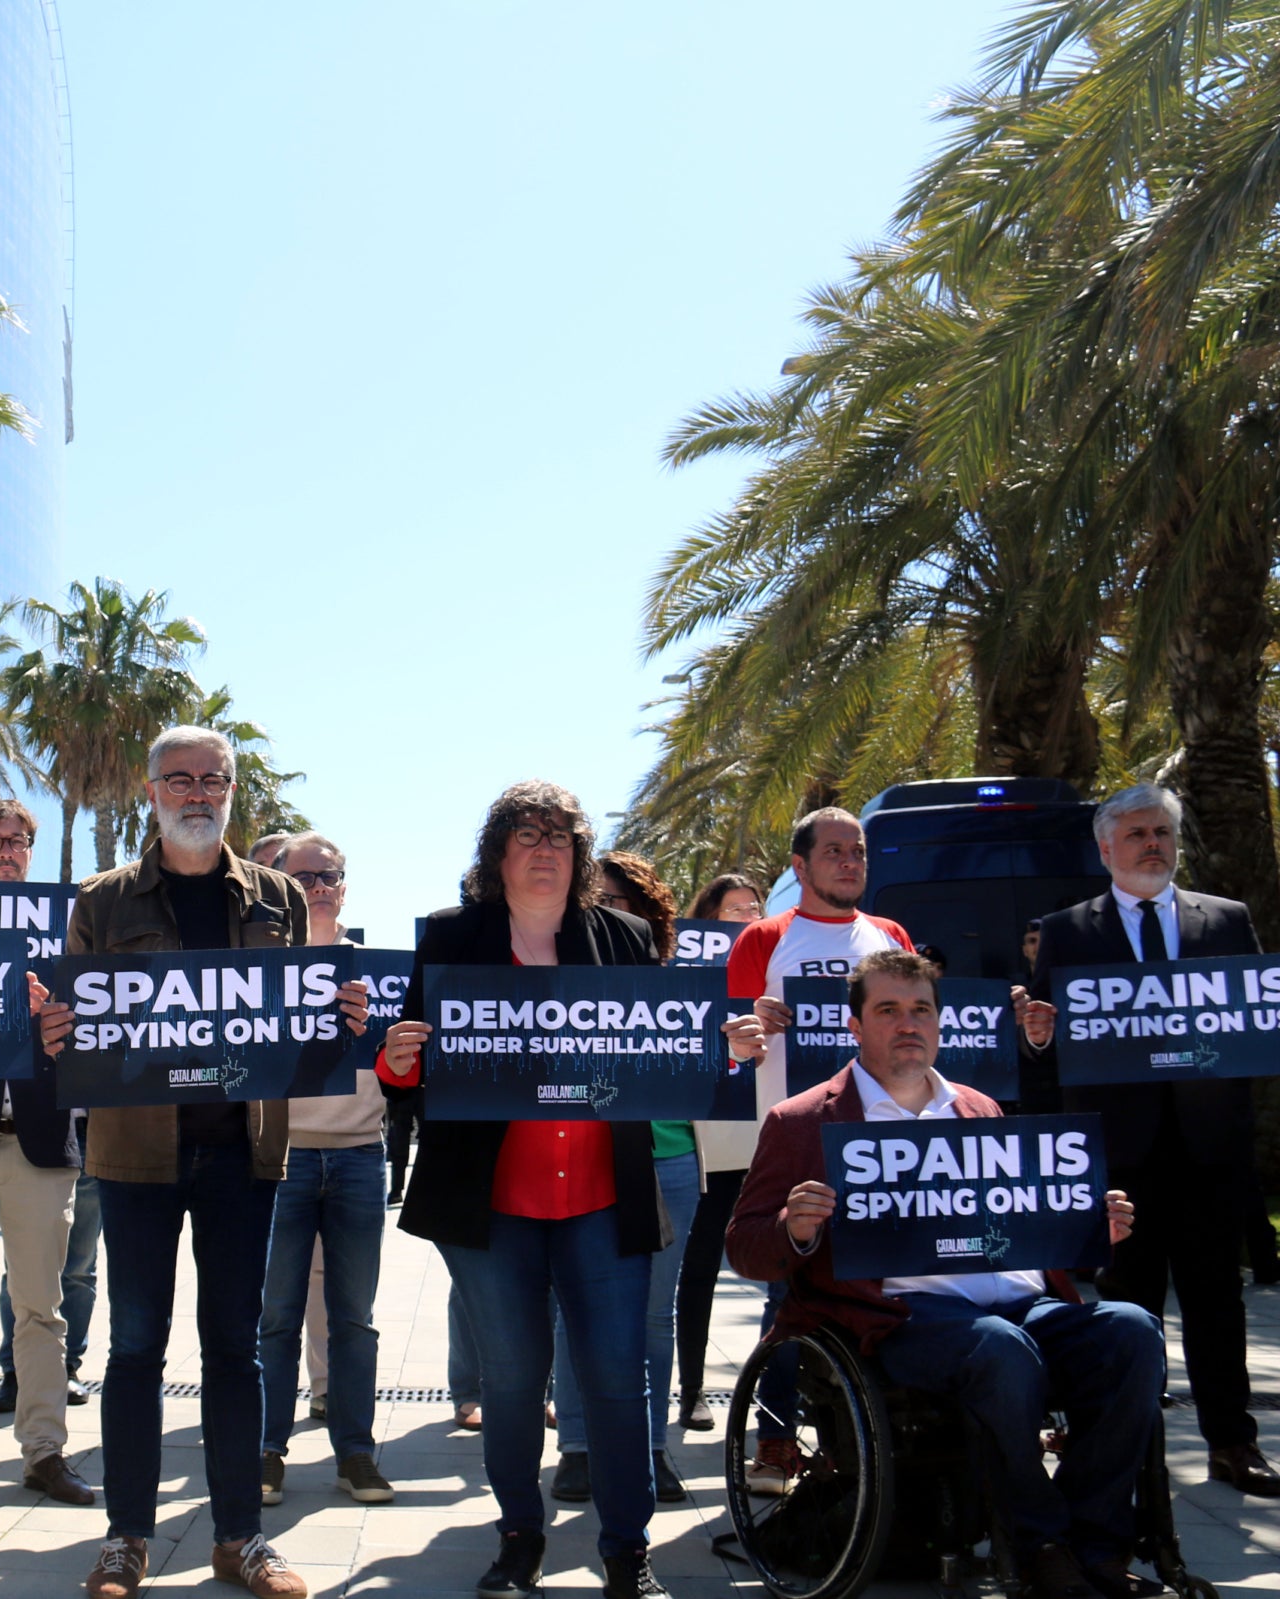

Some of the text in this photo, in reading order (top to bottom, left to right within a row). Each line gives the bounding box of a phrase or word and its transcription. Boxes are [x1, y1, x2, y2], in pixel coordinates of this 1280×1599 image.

[800, 959, 858, 977] RO
[73, 963, 337, 1016] SPAIN IS
[1066, 967, 1280, 1014] SPAIN IS
[440, 1000, 712, 1031] DEMOCRACY
[1069, 1009, 1280, 1041] SPYING ON U
[73, 1014, 338, 1051] SPYING ON US
[441, 1036, 703, 1054] UNDER SURVEILLANCE
[796, 1032, 859, 1047] UNDER
[169, 1068, 219, 1083] CATALANGATE
[537, 1085, 588, 1099] CATALANGATE
[841, 1131, 1090, 1184] SPAIN IS
[845, 1183, 1093, 1221] SPYING ON US
[936, 1237, 984, 1253] CATALANGATE
